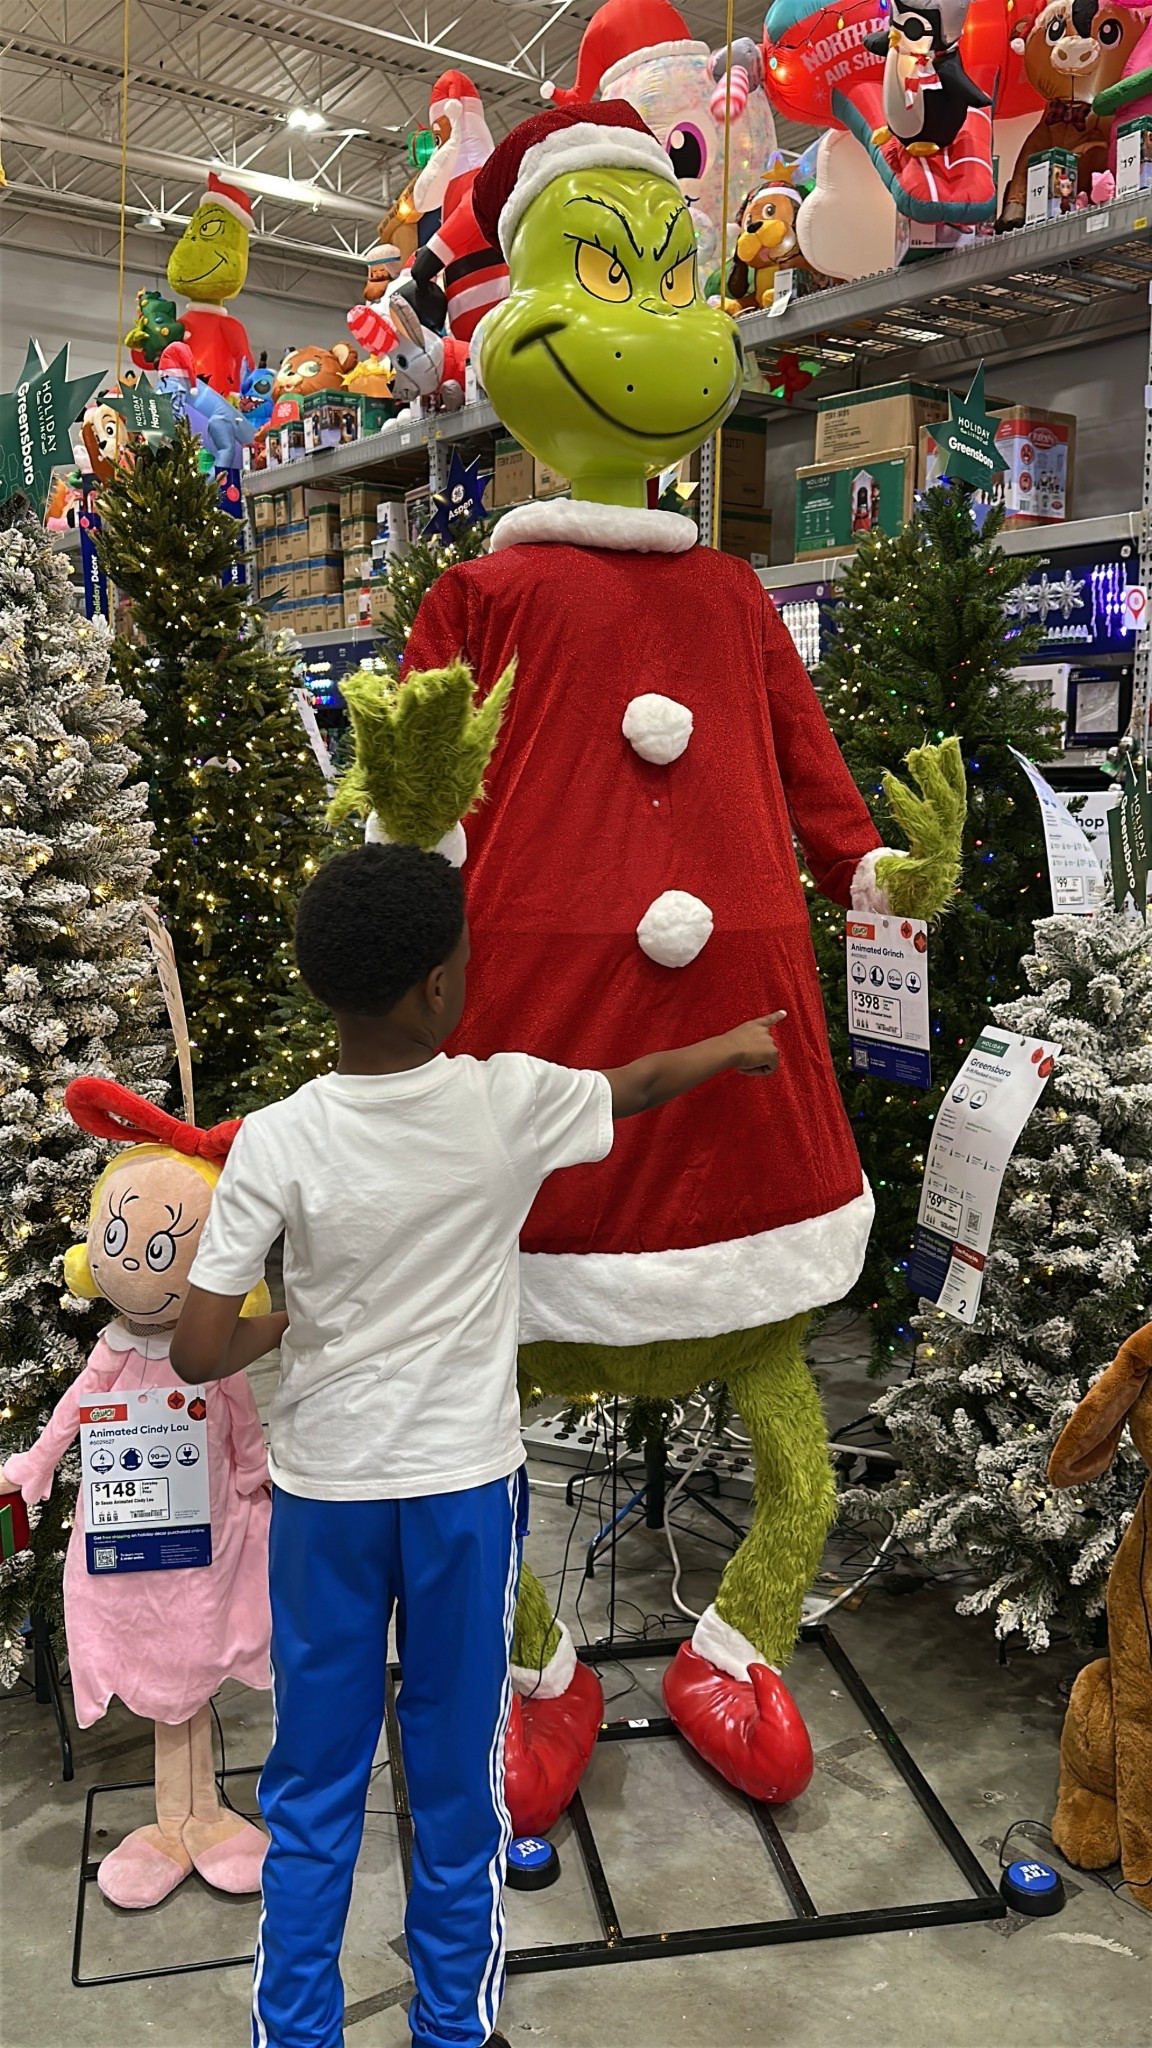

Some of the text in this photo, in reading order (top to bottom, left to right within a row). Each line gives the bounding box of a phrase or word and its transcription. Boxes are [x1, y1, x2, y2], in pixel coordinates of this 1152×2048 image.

[800, 20, 868, 74] NORTH
[824, 60, 852, 86] AIR
[38, 404, 47, 439] LIVING
[42, 380, 57, 453] HOLIDAY
[132, 394, 143, 427] HOLIDAY
[148, 398, 160, 429] Hayden
[18, 381, 34, 486] Greensboro
[958, 416, 990, 440] HOLIDAY
[948, 436, 994, 470] Greensboro
[448, 498, 474, 521] Aspen
[1072, 815, 1104, 830] hop
[1134, 792, 1147, 858] HOLIDAY
[1120, 795, 1136, 889] Greensboro
[851, 943, 904, 959] Animated Grinch
[854, 992, 880, 1010] $398
[981, 1040, 1004, 1050] HOLIDAY
[970, 1058, 1012, 1078] Greensboro
[958, 1300, 967, 1315] 2
[89, 1424, 189, 1438] Animated Cindy Lou
[94, 1482, 136, 1498] $148
[520, 1842, 545, 1858] TRY
[1019, 1864, 1041, 1873] ME
[1024, 1868, 1050, 1882] TRY
